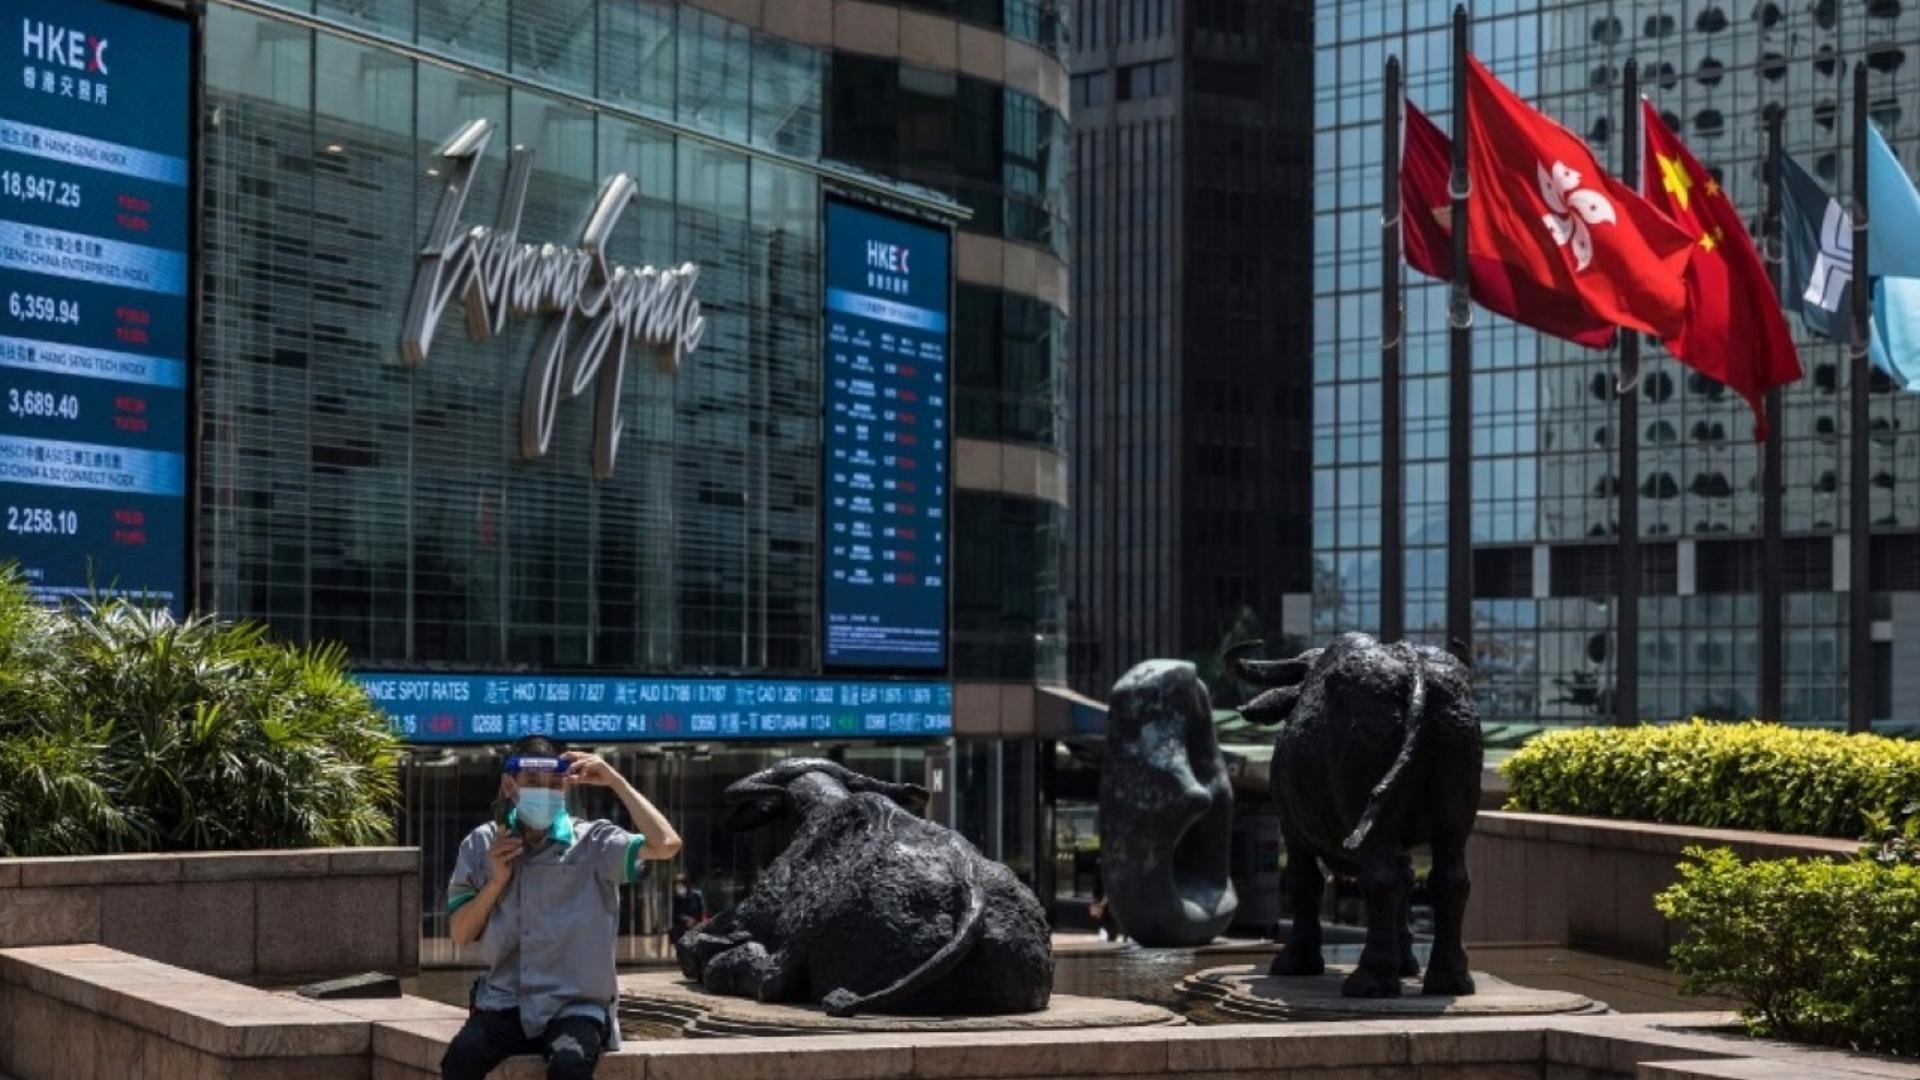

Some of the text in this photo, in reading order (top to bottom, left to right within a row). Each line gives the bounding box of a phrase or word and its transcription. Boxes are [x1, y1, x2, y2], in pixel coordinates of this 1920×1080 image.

[23, 17, 108, 75] HKEX
[2, 169, 81, 208] 18,947.25
[867, 239, 909, 274] HKEX
[9, 291, 80, 325] 6,359.94
[69, 354, 92, 370] SENG
[8, 388, 79, 420] 3,689.40
[7, 506, 78, 535] 2,258.10
[399, 680, 430, 701] SPOT
[432, 681, 470, 701] RATES
[513, 682, 536, 701] HKD
[581, 714, 624, 732] ENERGY
